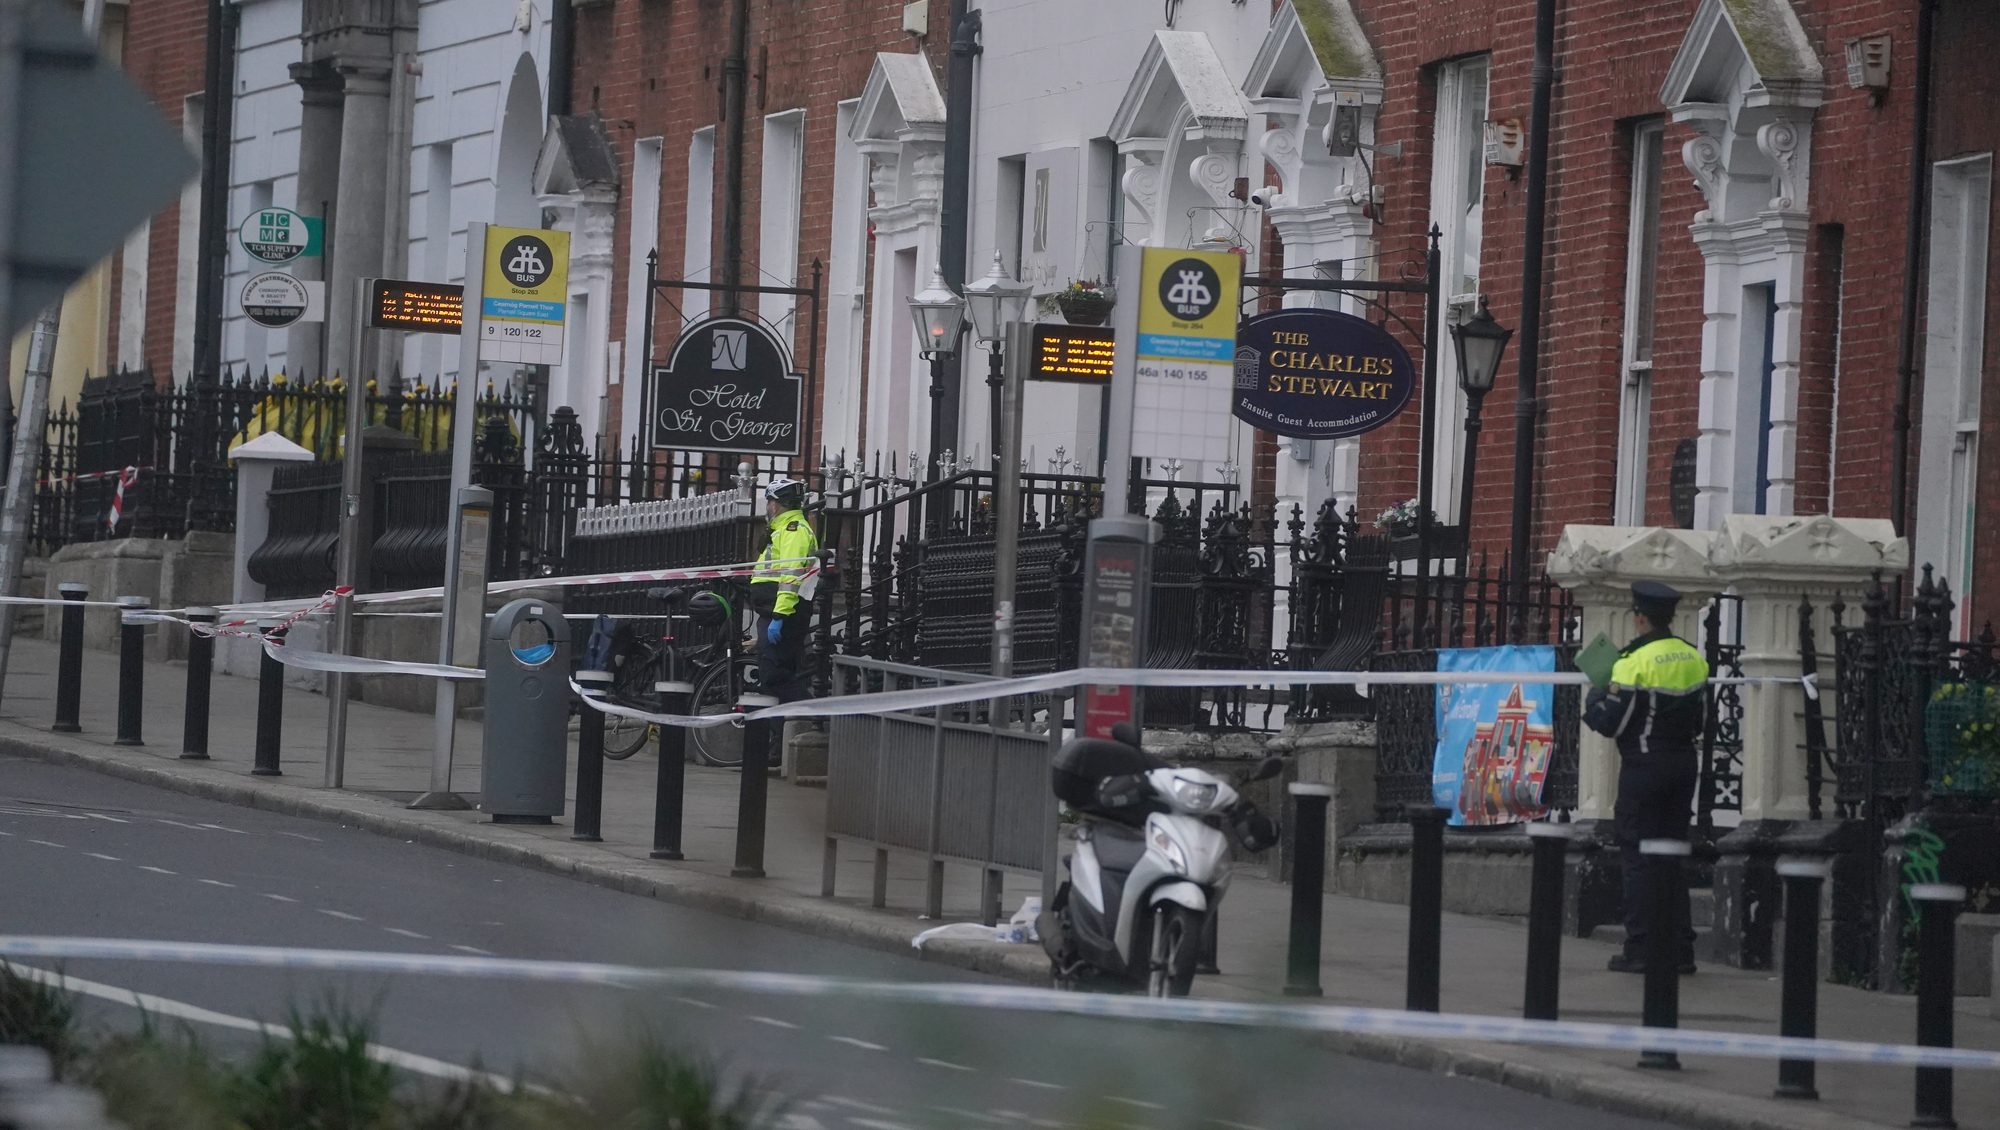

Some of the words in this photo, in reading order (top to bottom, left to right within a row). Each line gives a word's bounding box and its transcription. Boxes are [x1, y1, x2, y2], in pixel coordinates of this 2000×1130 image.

[263, 213, 272, 225] T
[278, 214, 288, 226] C
[261, 229, 272, 240] M
[251, 243, 266, 252] TCM
[267, 245, 291, 253] SUPPLY
[262, 251, 286, 260] CLINIC
[516, 274, 535, 283] BUS
[244, 281, 259, 301] DUBLIN
[292, 284, 305, 303] CLINIC
[518, 302, 539, 310] Parnell
[1177, 304, 1200, 315] BUS
[516, 309, 537, 317] Square
[1171, 321, 1189, 329] Stop
[488, 326, 495, 335] 9
[504, 328, 521, 337] 120
[525, 329, 542, 338] 122
[1272, 331, 1309, 346] THE
[1269, 350, 1393, 376] CHARLES
[1137, 367, 1159, 377] 46a
[1164, 369, 1183, 379] 140
[1188, 371, 1208, 380] 155
[1268, 374, 1393, 400] STEWART
[689, 383, 767, 410] Hotel
[1241, 397, 1273, 420] Ensuite
[1277, 413, 1303, 426] Guest
[1307, 409, 1378, 428] Accommodation
[660, 408, 703, 432] St.
[709, 412, 793, 445] George
[1655, 652, 1694, 664] GARDA
